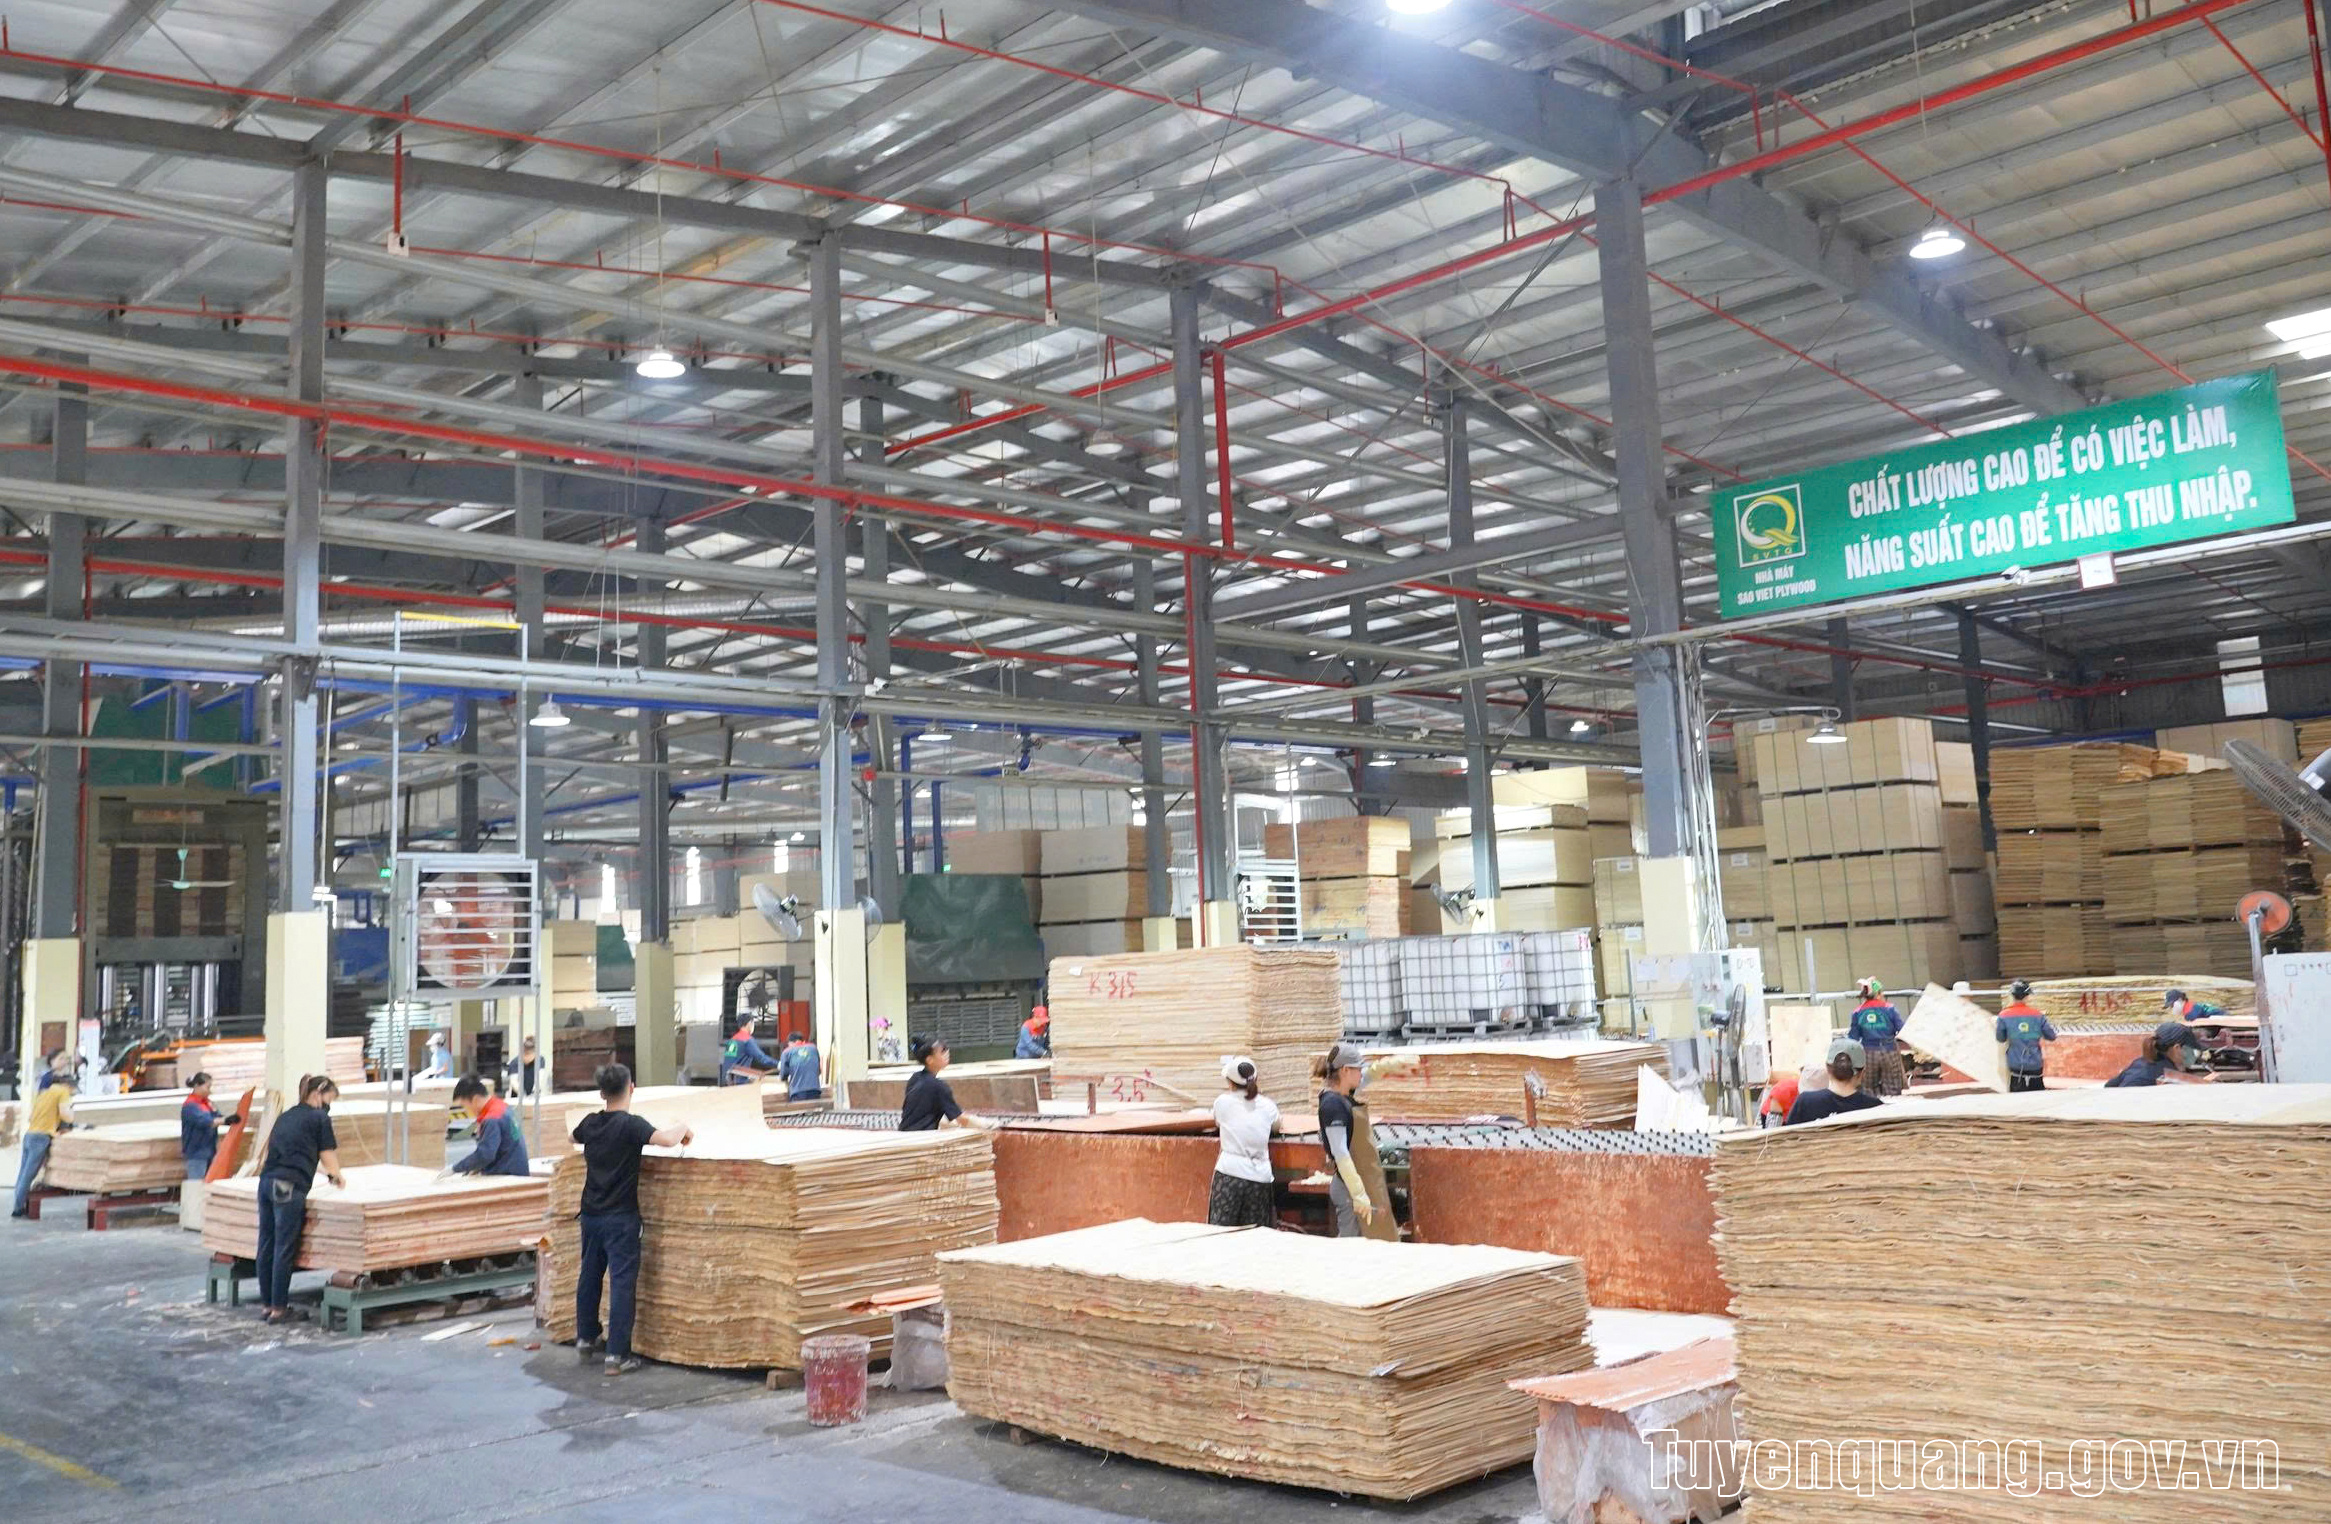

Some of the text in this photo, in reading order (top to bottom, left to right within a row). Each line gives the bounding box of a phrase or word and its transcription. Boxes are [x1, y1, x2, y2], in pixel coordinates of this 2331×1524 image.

[1848, 403, 2238, 519] CHẤT LƯỢNG CAO ĐỂ CÓ VIỆC LÀM,
[1844, 464, 2258, 580] NĂNG SUẤT CAO ĐỂ TĂNG THU NHẬP.
[1775, 579, 1816, 599] PLYWOOD
